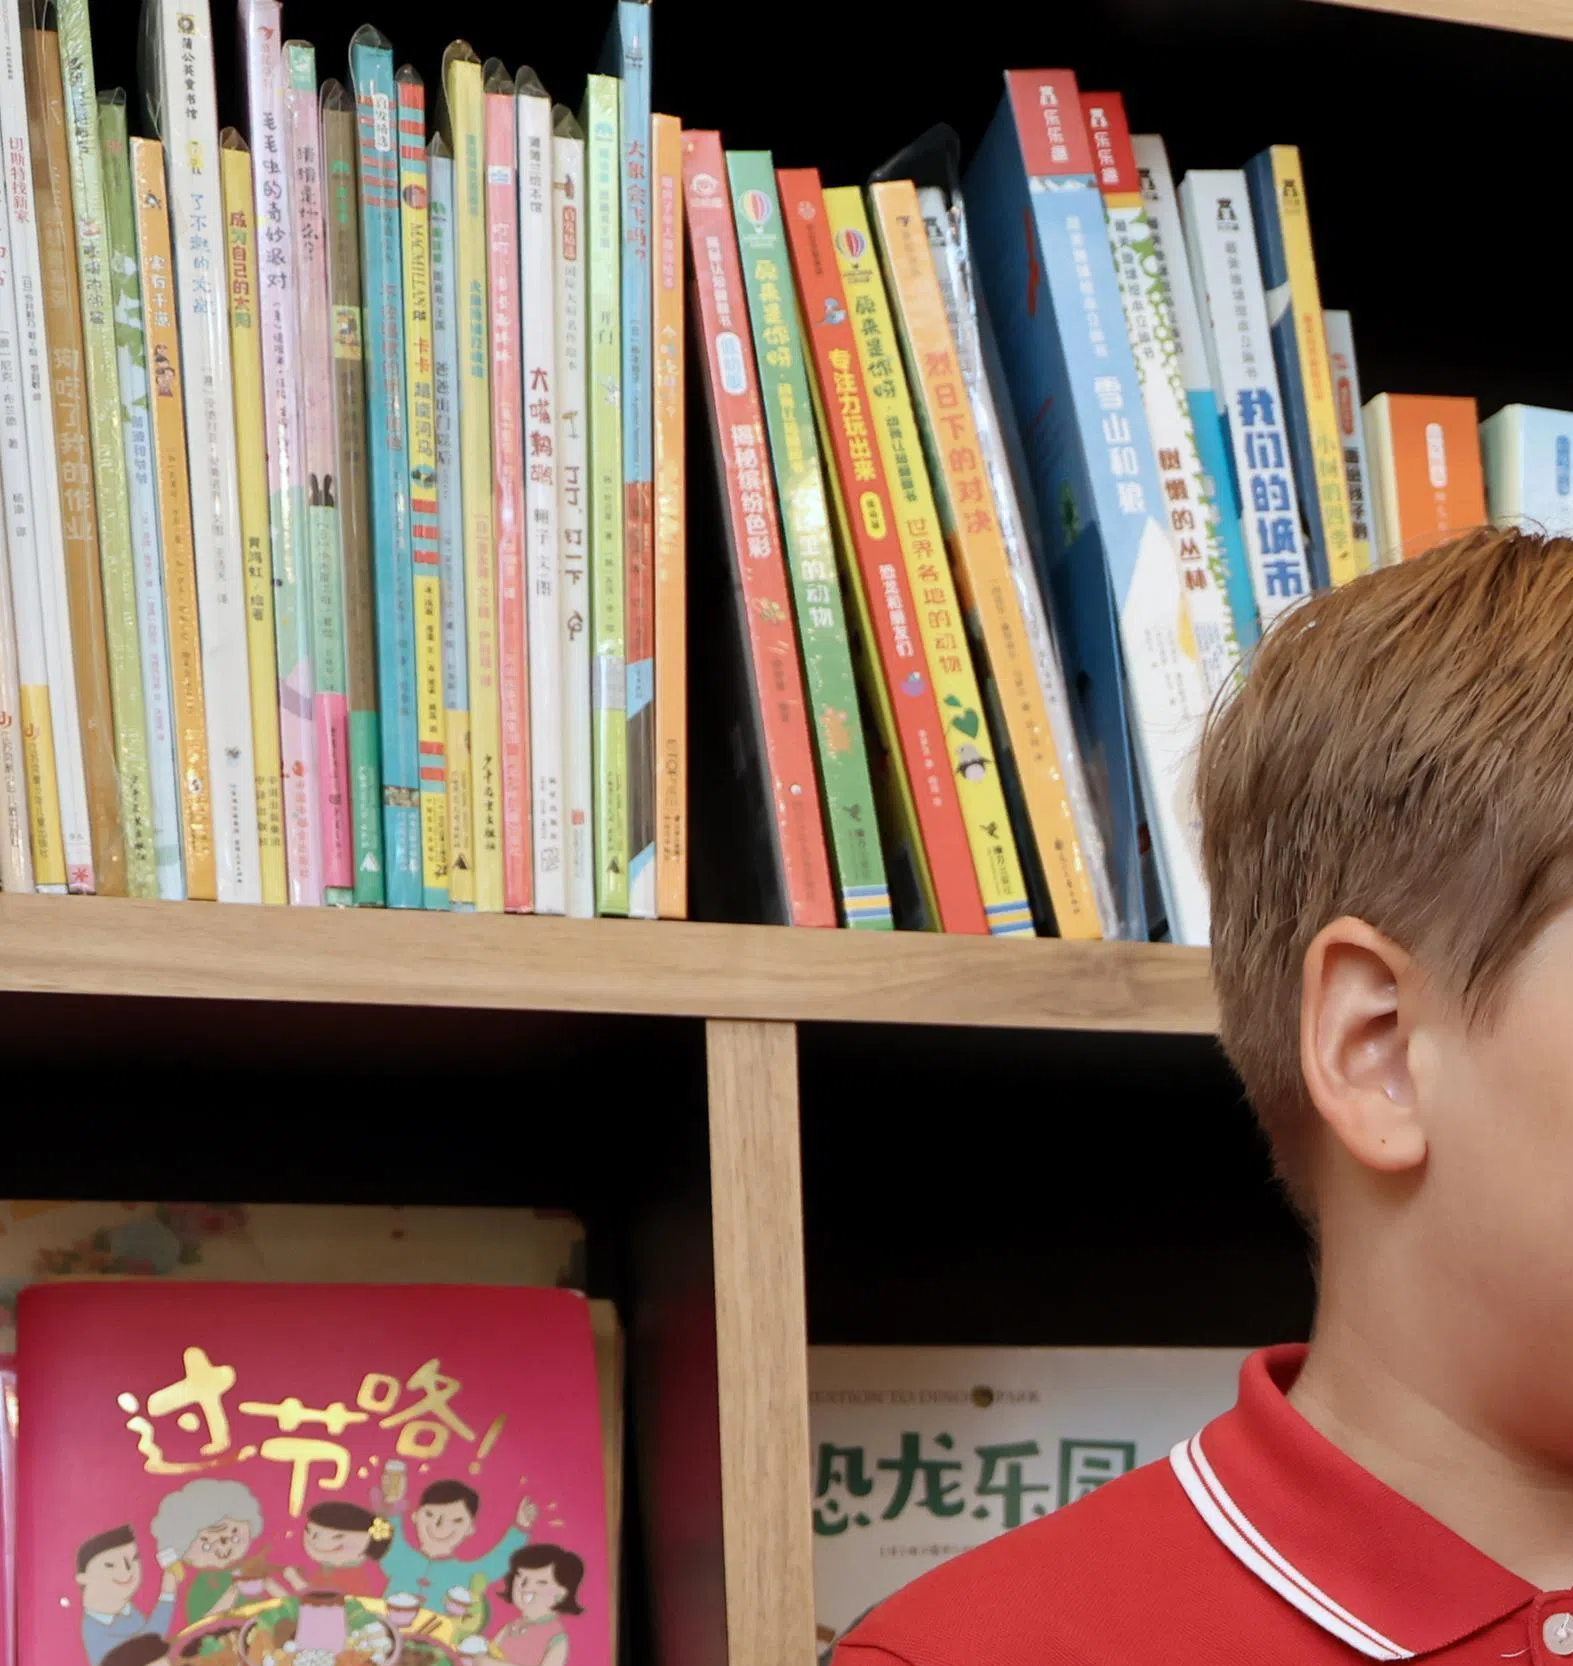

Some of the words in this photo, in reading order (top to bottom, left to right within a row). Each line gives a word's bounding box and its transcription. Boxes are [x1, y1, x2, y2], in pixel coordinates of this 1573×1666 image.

[181, 37, 198, 120] 蒲公英童书馆
[828, 347, 878, 482] 专注力玩出来
[1093, 375, 1147, 516] 雪山和狼
[1157, 447, 1208, 591] 树懒的丛林
[1236, 387, 1302, 598] 我们的城市
[906, 517, 963, 673] 世界各地的动物
[117, 1346, 508, 1518] 过节咯!
[813, 1430, 1138, 1537] 恐龙乐园
